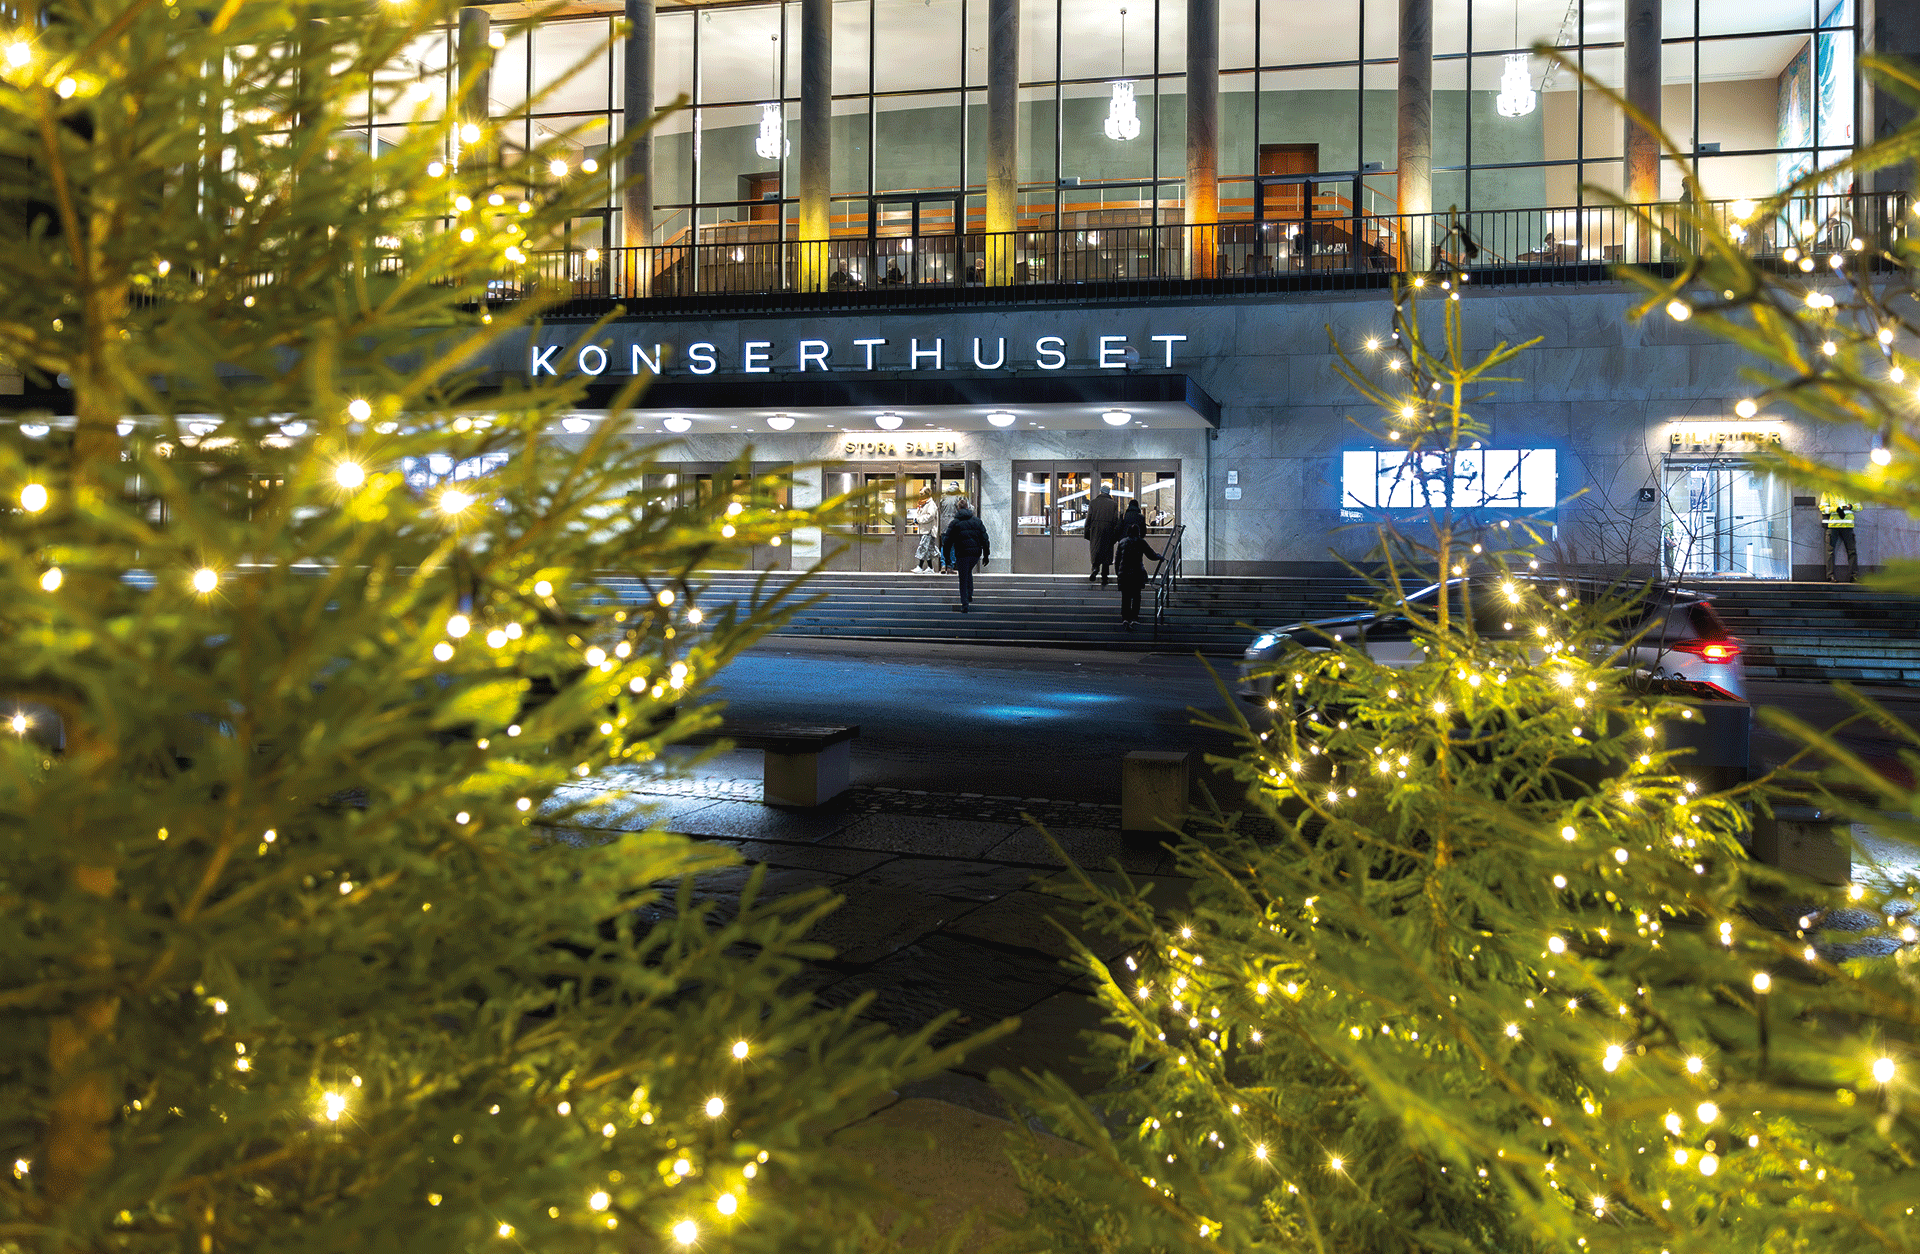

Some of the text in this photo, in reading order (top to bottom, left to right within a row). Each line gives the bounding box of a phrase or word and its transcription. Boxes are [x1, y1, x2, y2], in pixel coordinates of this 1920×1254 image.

[531, 335, 1187, 376] KONSERTHUSET
[1670, 431, 1782, 445] BILJETTER
[845, 441, 956, 454] STORA SALEN
